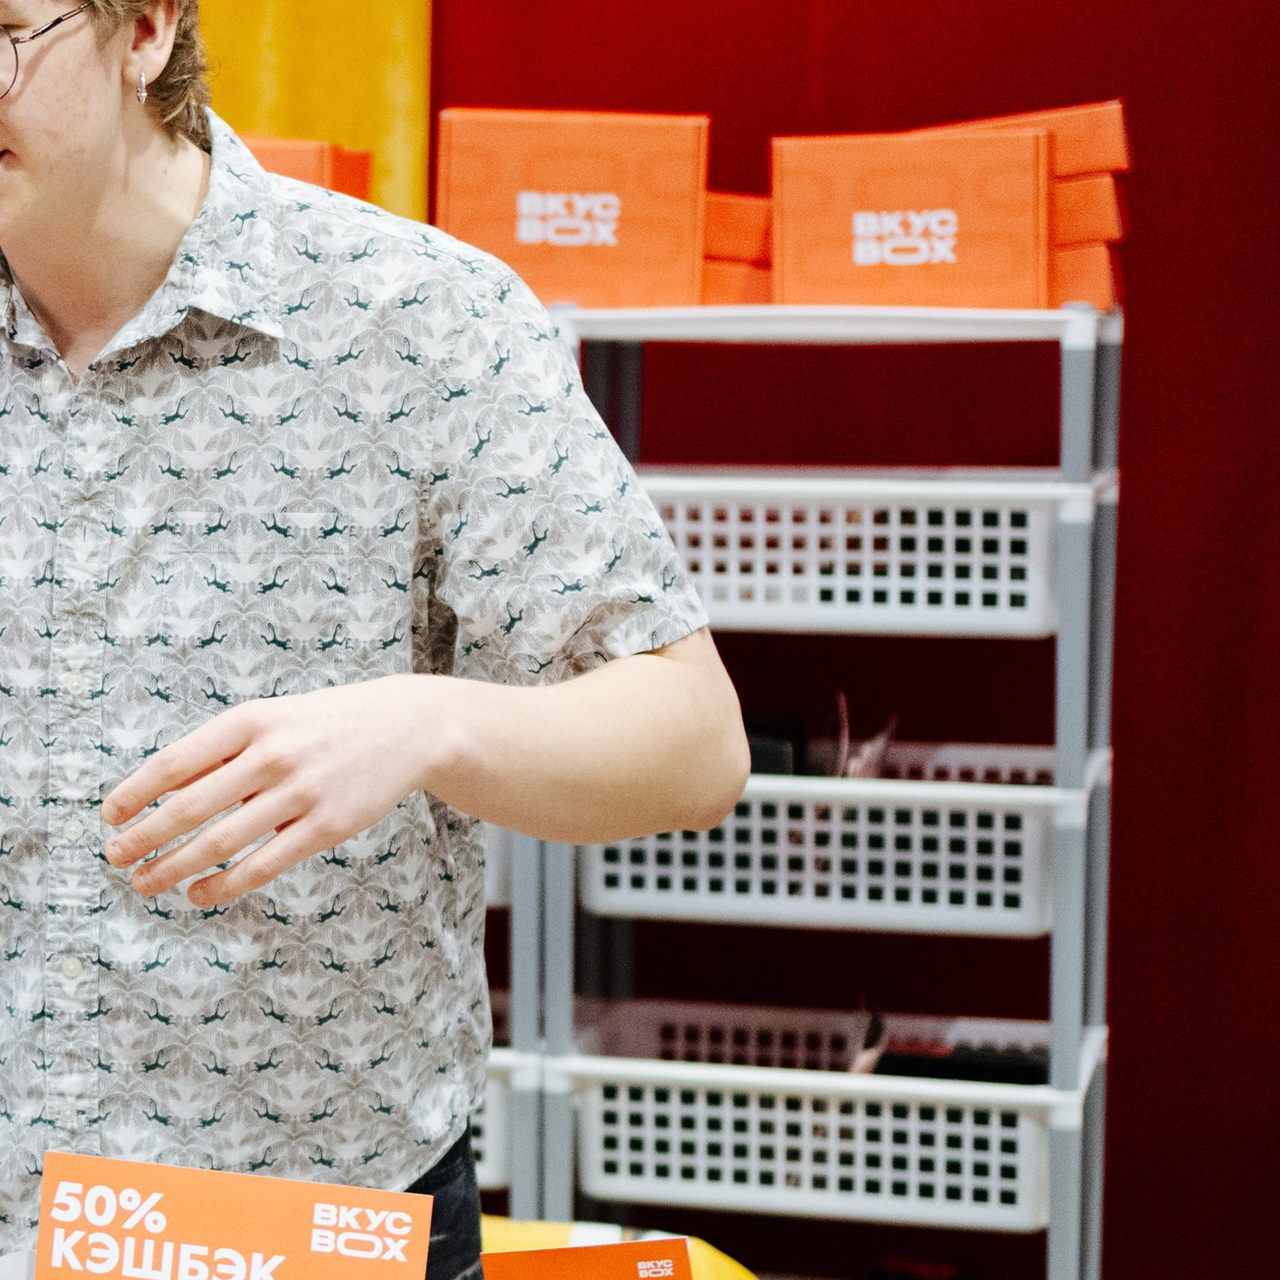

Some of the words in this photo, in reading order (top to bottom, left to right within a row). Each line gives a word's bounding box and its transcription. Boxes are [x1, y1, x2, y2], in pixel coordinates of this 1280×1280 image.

[516, 190, 620, 220] ВКУС
[515, 218, 619, 247] BOX
[851, 208, 959, 238] ВКУС
[851, 235, 958, 266] BOX
[49, 1181, 168, 1234] 50%
[312, 1202, 413, 1235] ВКУС
[309, 1228, 410, 1262] BOX
[637, 1259, 673, 1269] ВКУС
[638, 1268, 674, 1278] BOX
